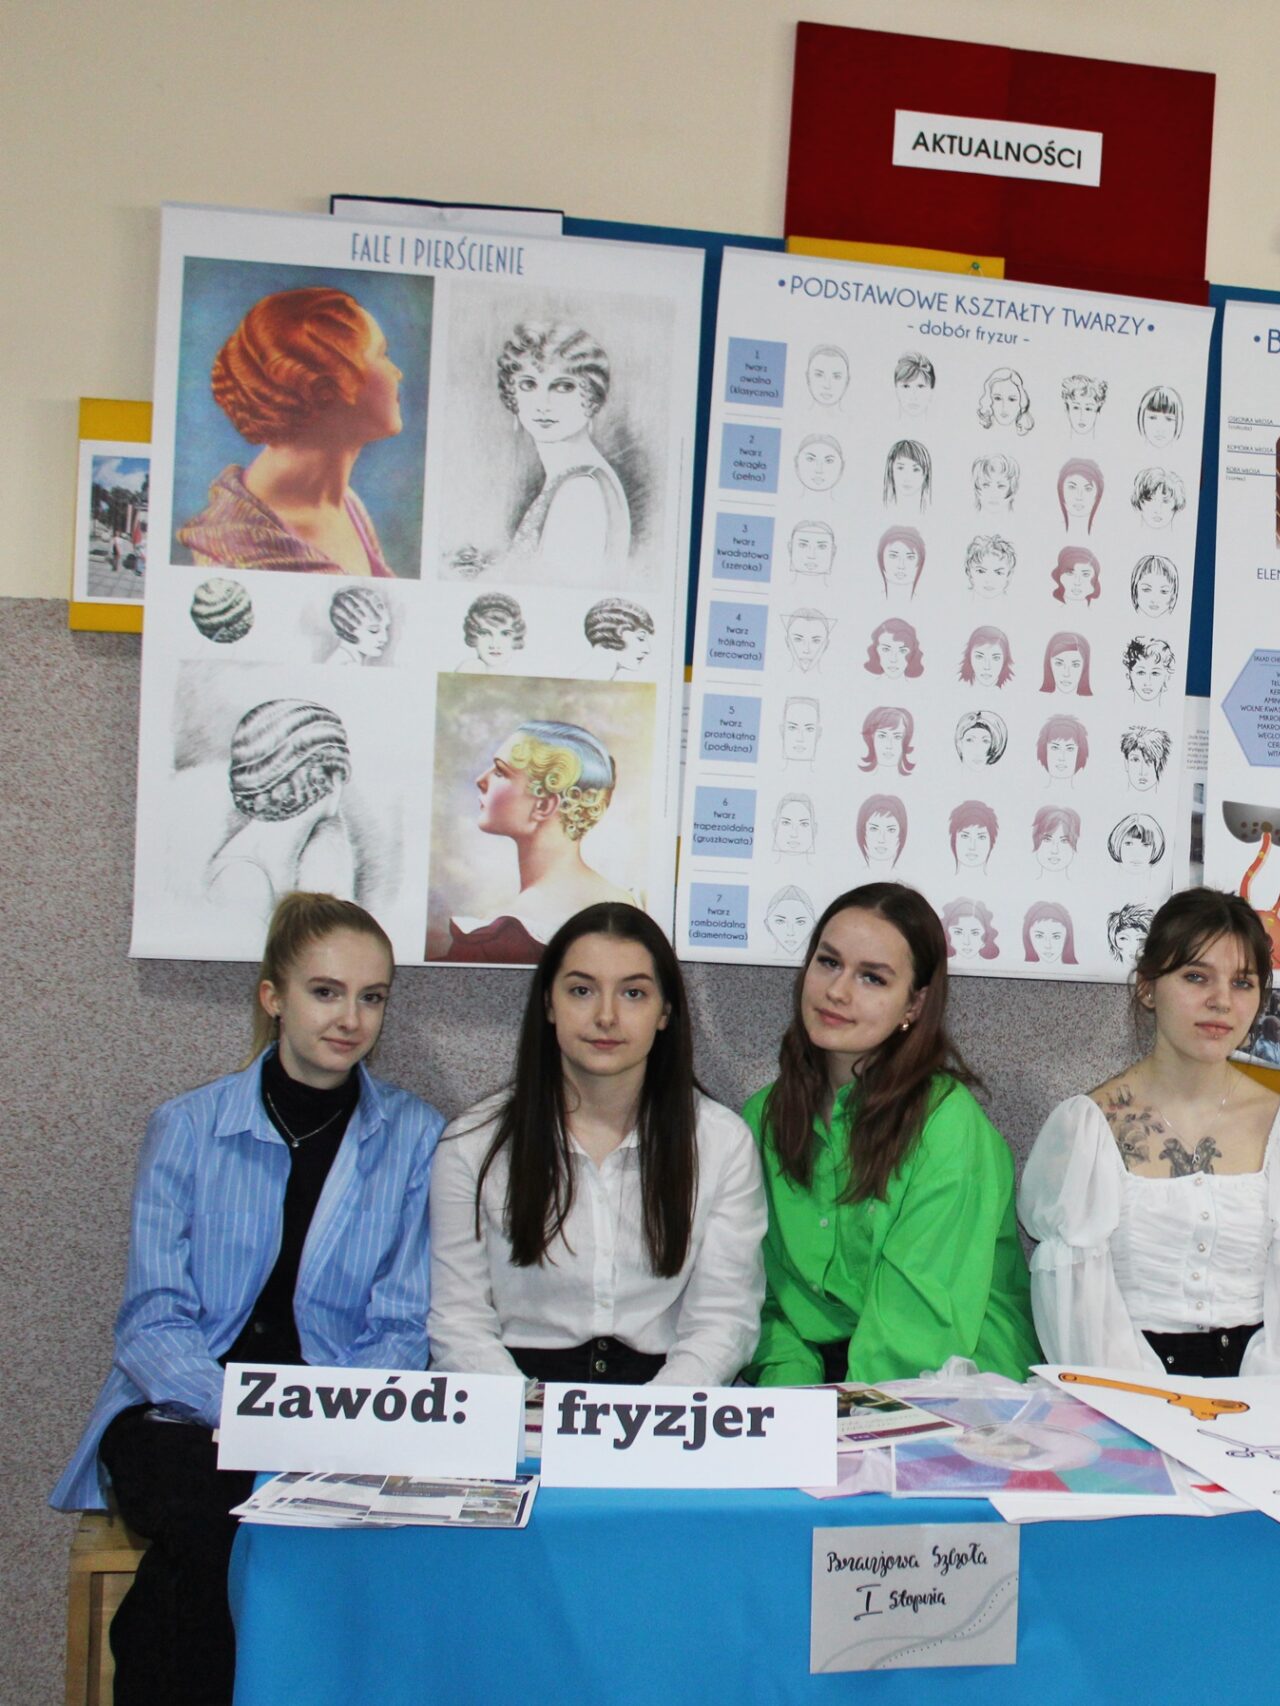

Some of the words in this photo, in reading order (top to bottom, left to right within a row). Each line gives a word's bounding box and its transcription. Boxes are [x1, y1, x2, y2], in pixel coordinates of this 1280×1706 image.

[912, 131, 1082, 169] AKTUALNOŚCI
[351, 232, 391, 264] FALE
[413, 236, 525, 276] PIERŚCIENIE
[790, 275, 948, 313] PODSTAWOWE
[955, 295, 1055, 325] KSZTAŁTY
[1062, 307, 1145, 336] TWARZY
[919, 319, 970, 339] dobór
[975, 325, 1019, 345] fryzur
[236, 1371, 469, 1425] Zawód:
[556, 1389, 775, 1451] fryzjer
[853, 1583, 883, 1622] I
[889, 1587, 947, 1614] Stopnia
